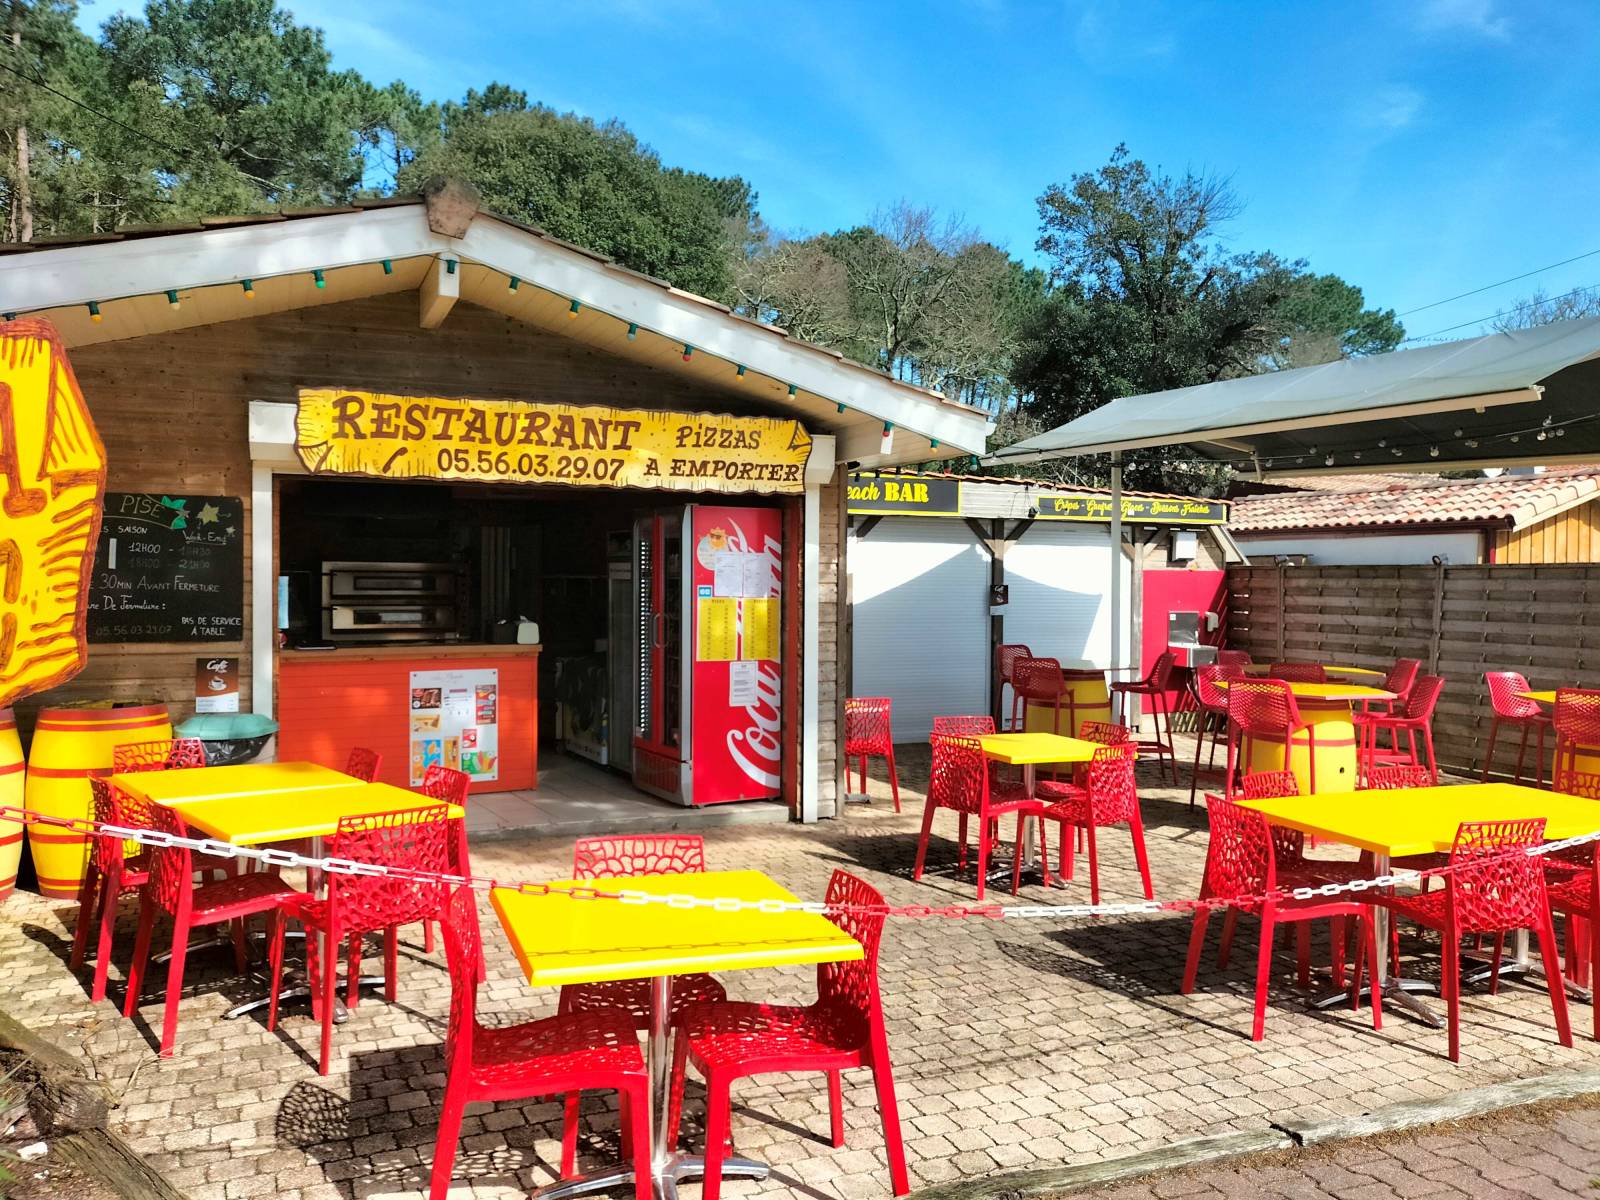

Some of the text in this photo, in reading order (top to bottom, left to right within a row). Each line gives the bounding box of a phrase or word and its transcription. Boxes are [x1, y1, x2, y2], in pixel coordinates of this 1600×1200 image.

[331, 395, 641, 451] RESTAURANT
[437, 448, 624, 480] 05.56.03.29.07
[643, 457, 801, 483] A EMPORTER
[848, 482, 929, 502] each BAR
[119, 495, 162, 518] PISE
[118, 525, 148, 534] SAISON
[128, 542, 161, 554] 12H00
[103, 595, 117, 610] De
[197, 616, 208, 626] DE
[211, 616, 242, 626] SERVICE
[199, 627, 226, 636] TABLE
